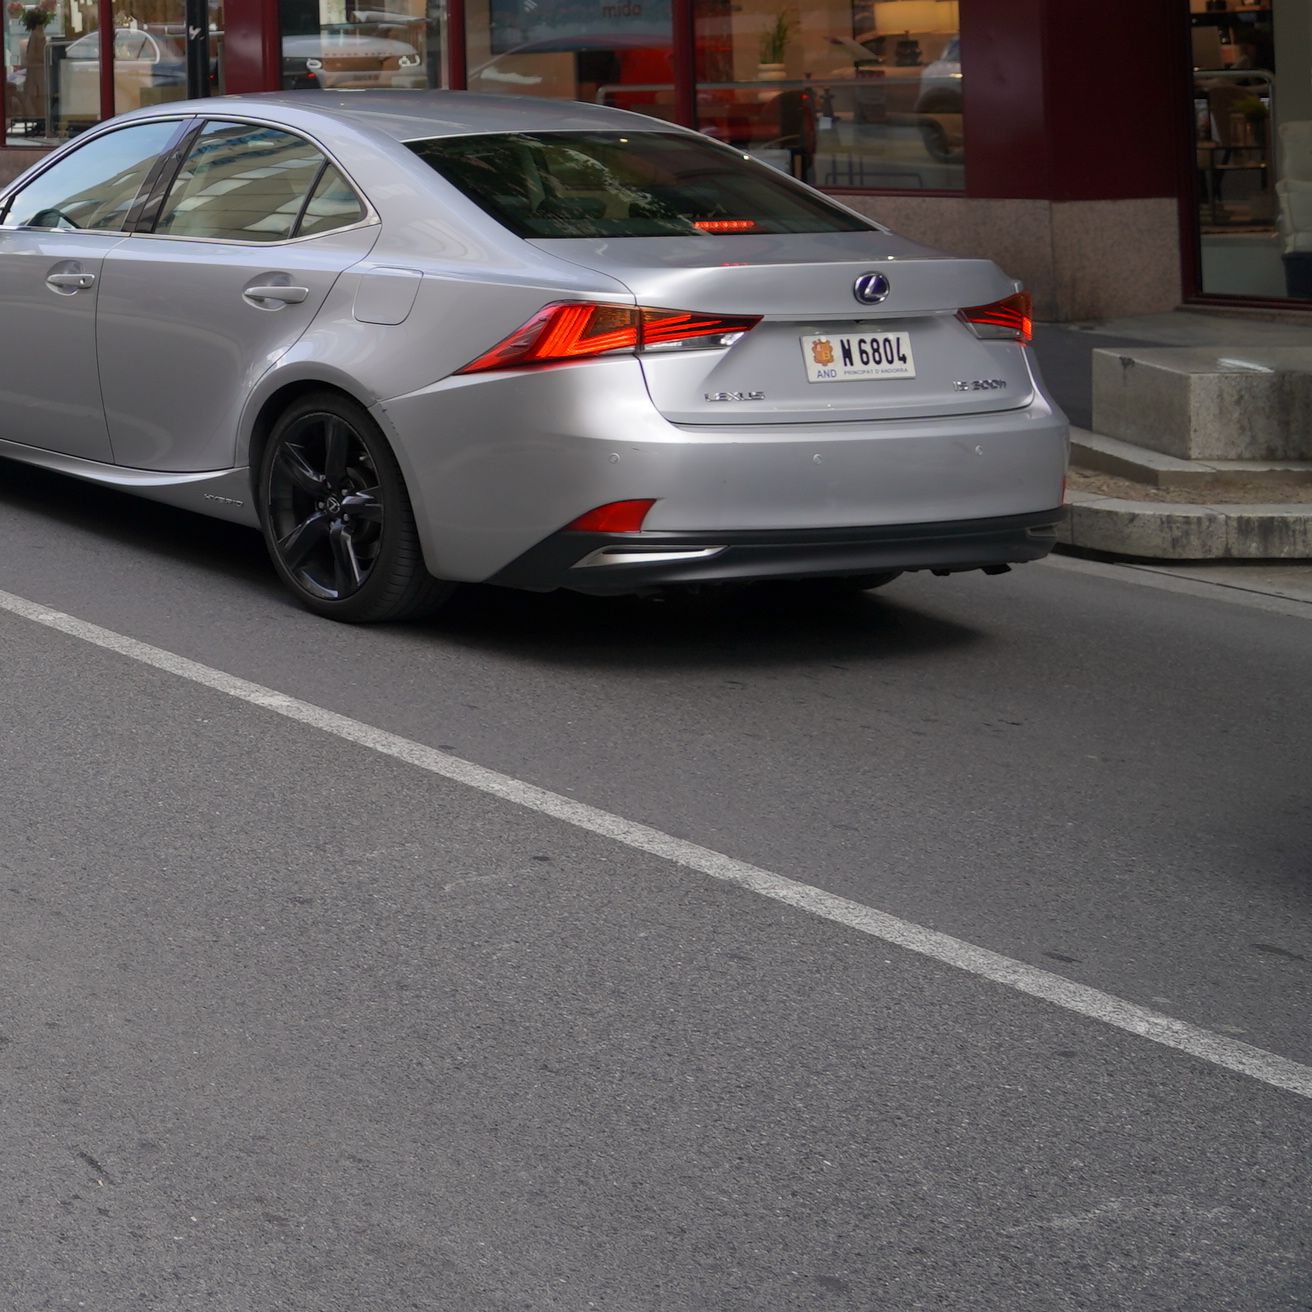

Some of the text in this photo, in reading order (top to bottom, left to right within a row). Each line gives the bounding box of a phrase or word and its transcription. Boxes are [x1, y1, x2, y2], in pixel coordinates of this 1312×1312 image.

[840, 337, 907, 367] N 6804
[816, 369, 837, 378] AND
[704, 391, 766, 402] LEXUS
